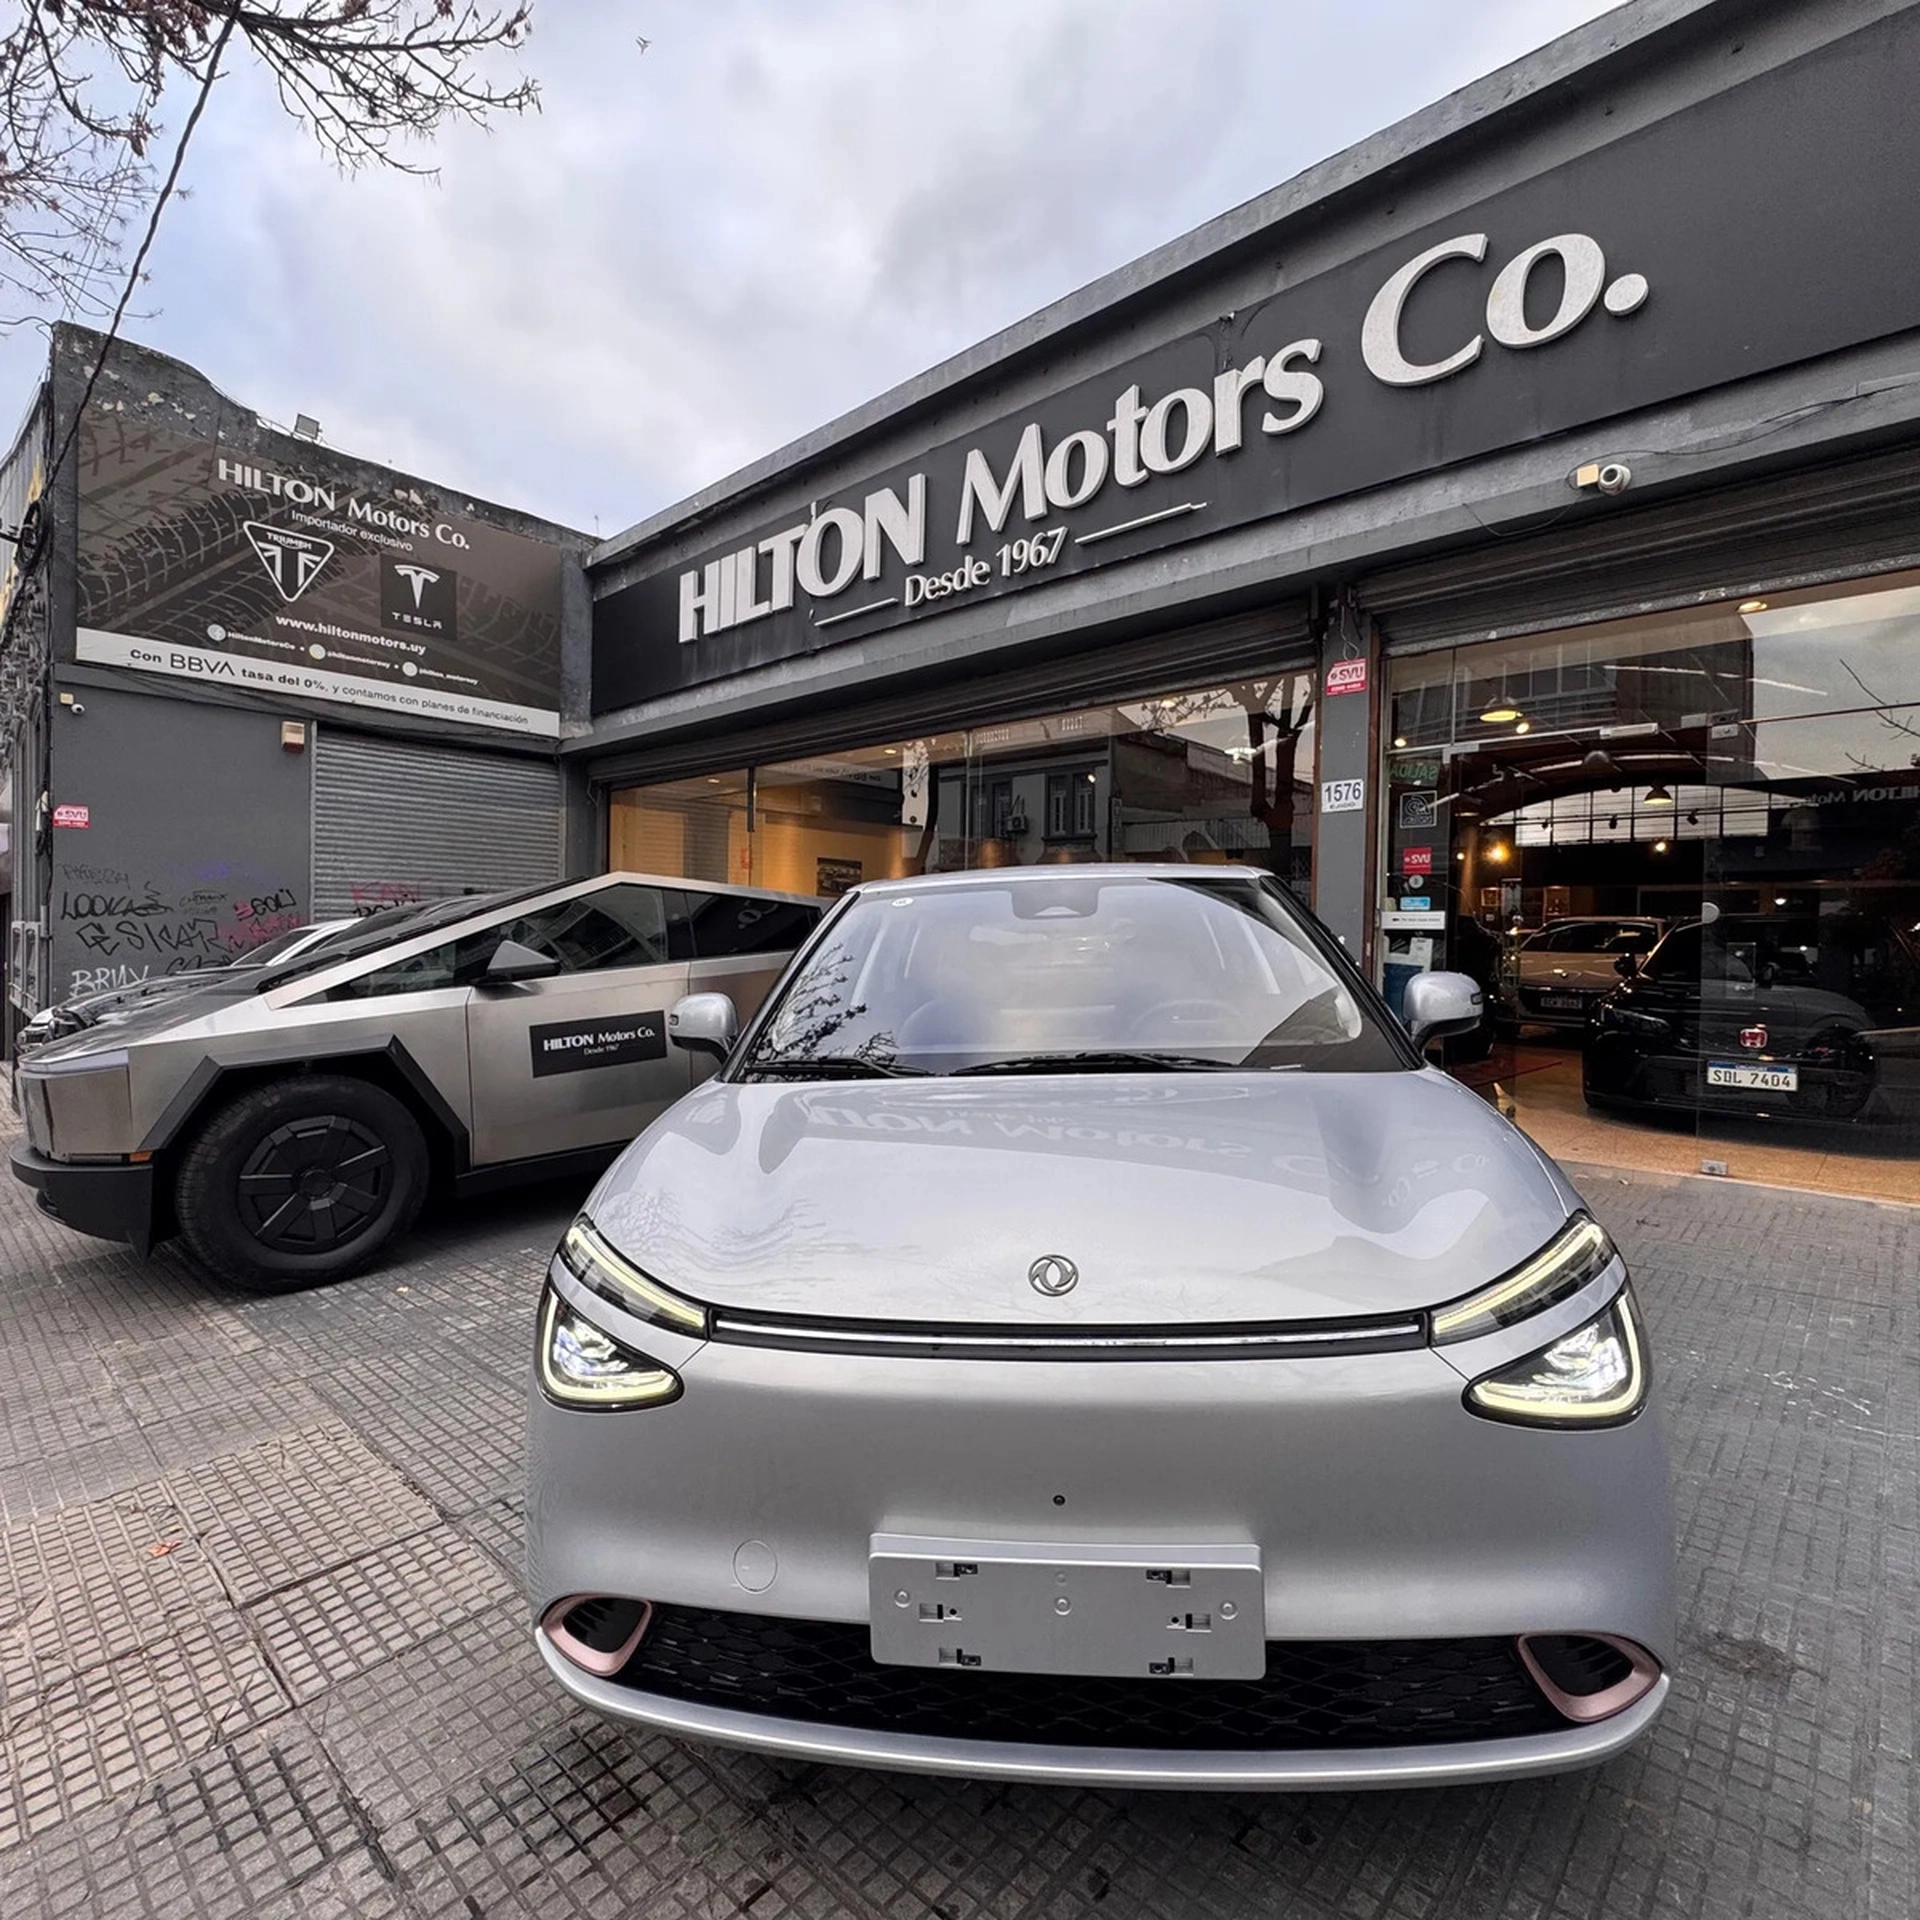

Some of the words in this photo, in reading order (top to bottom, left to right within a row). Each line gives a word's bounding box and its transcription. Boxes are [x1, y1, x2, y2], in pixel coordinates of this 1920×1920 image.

[679, 473, 926, 643] HILTON
[956, 338, 1325, 545] Motors
[1361, 232, 1649, 387] Co.
[218, 459, 335, 511] HILTON
[348, 498, 430, 538] Motors
[435, 524, 470, 549] Co.
[291, 510, 357, 535] Importador
[360, 530, 413, 551] exclusivo
[904, 555, 991, 607] Desde
[996, 525, 1068, 577] 1967
[276, 615, 426, 655] www.hiltonmotors.uy
[392, 612, 442, 629] TESLA
[130, 649, 162, 663] Con
[170, 653, 235, 676] BBVA
[241, 668, 274, 682] tasa
[278, 674, 300, 686] del
[332, 685, 339, 694] y
[342, 686, 396, 702] contamos
[399, 696, 418, 706] con
[422, 700, 455, 713] planes
[457, 705, 470, 715] de
[1339, 666, 1363, 681] SVU
[1325, 782, 1361, 802] 1576
[1411, 854, 1431, 864] SVU
[543, 1034, 594, 1051] HILTON
[598, 1029, 635, 1043] Motors
[637, 1026, 655, 1037] Co.
[1750, 1073, 1790, 1088] 7404
